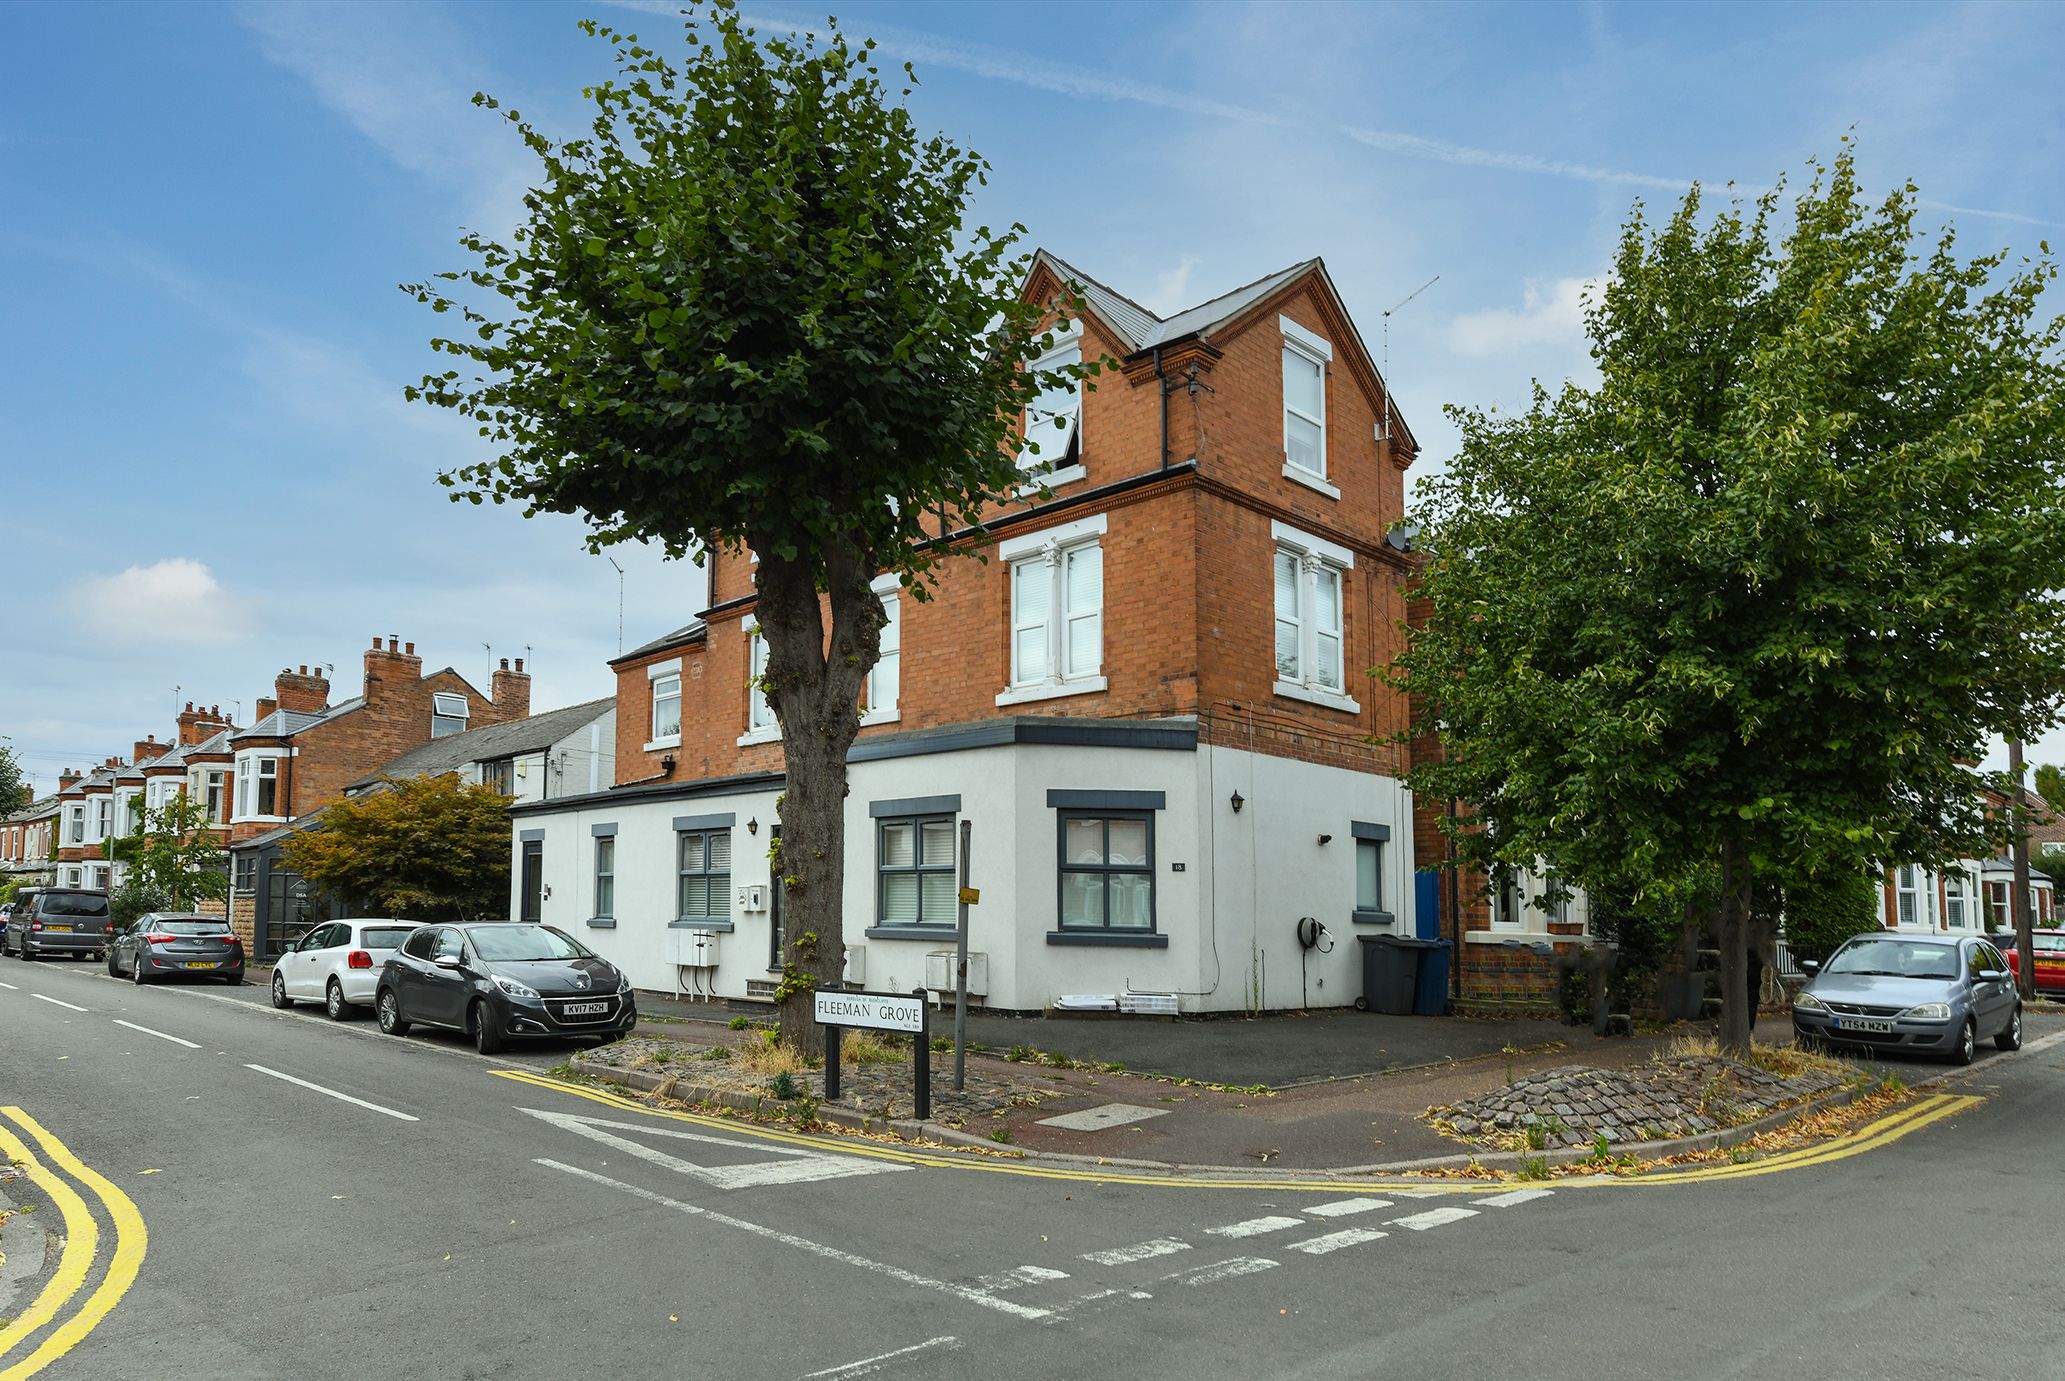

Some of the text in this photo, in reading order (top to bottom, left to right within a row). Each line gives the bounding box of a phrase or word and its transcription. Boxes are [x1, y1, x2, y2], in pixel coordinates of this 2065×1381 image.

[568, 1003, 604, 1013] KV17 HZH
[818, 1001, 919, 1022] FLEEMAN GROVE
[1841, 1019, 1865, 1029] YT54
